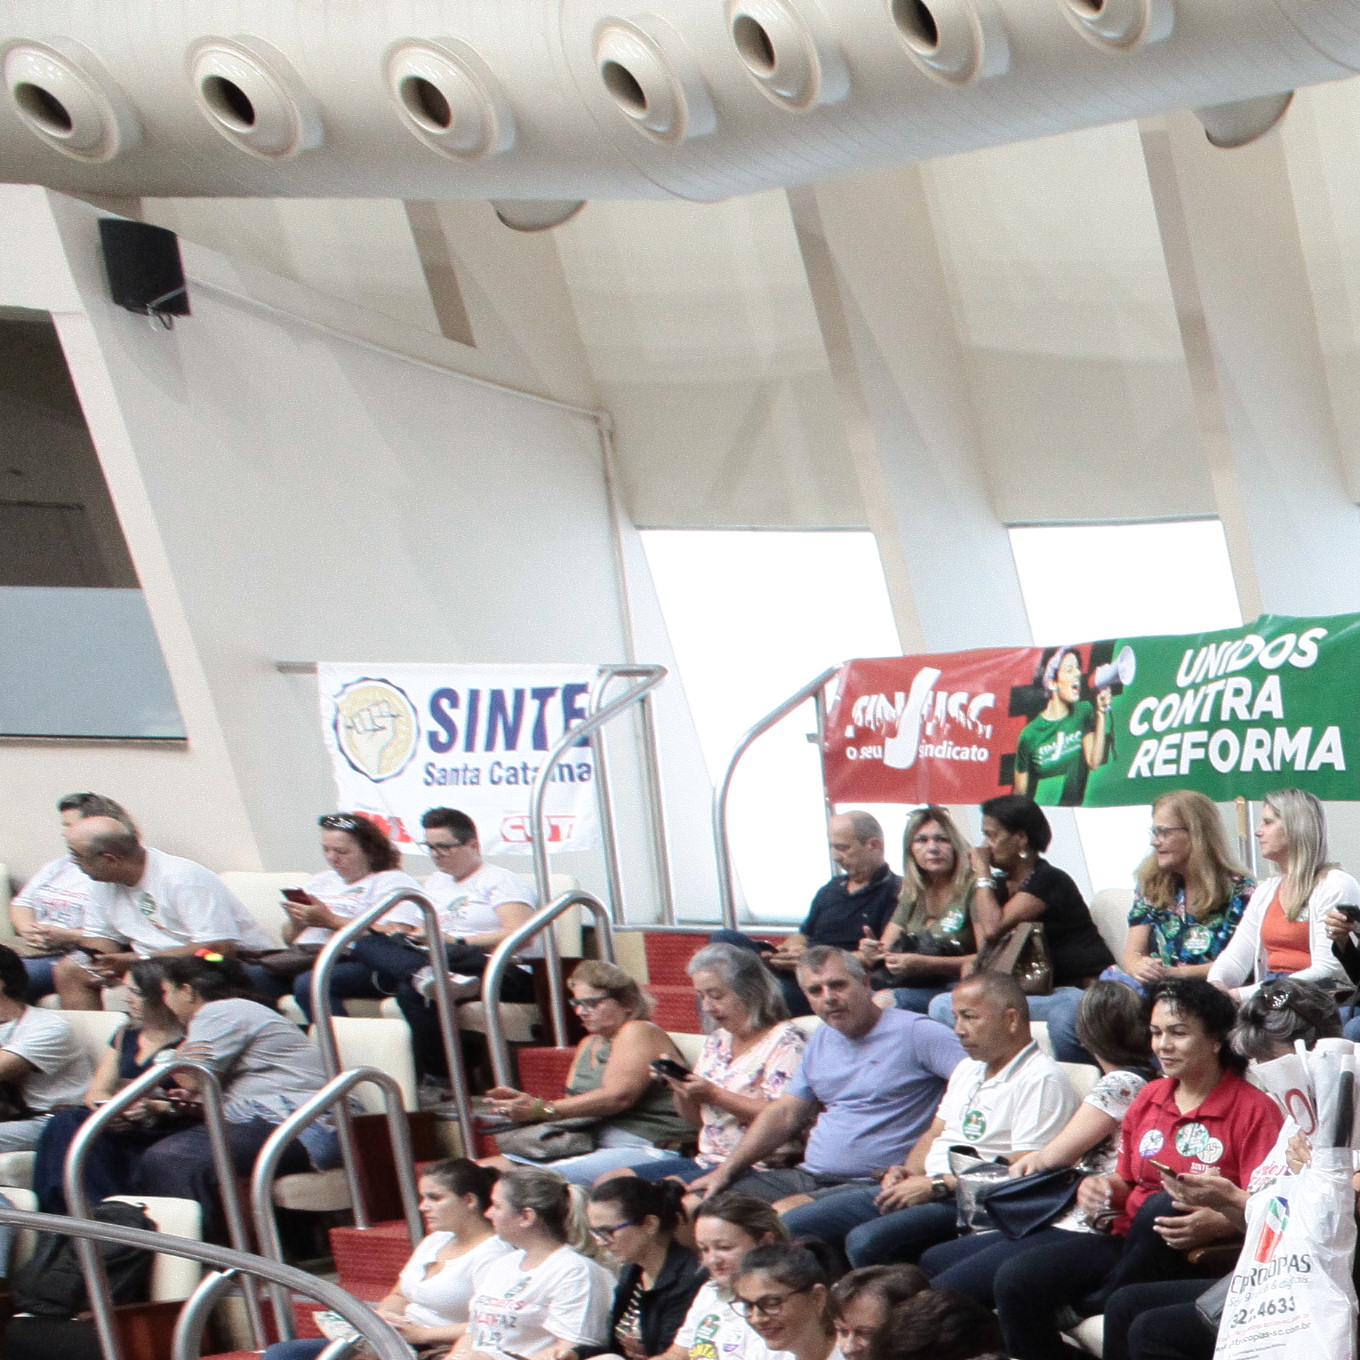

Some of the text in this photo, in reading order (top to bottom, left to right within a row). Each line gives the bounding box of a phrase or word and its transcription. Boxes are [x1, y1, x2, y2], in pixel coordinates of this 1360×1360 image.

[1174, 626, 1329, 688] UNIDOS
[426, 681, 591, 753] SINTE
[1129, 674, 1284, 737] CONTRA
[423, 761, 481, 787] Santa
[919, 739, 989, 762] sindicato
[1127, 724, 1348, 779] REFORMA
